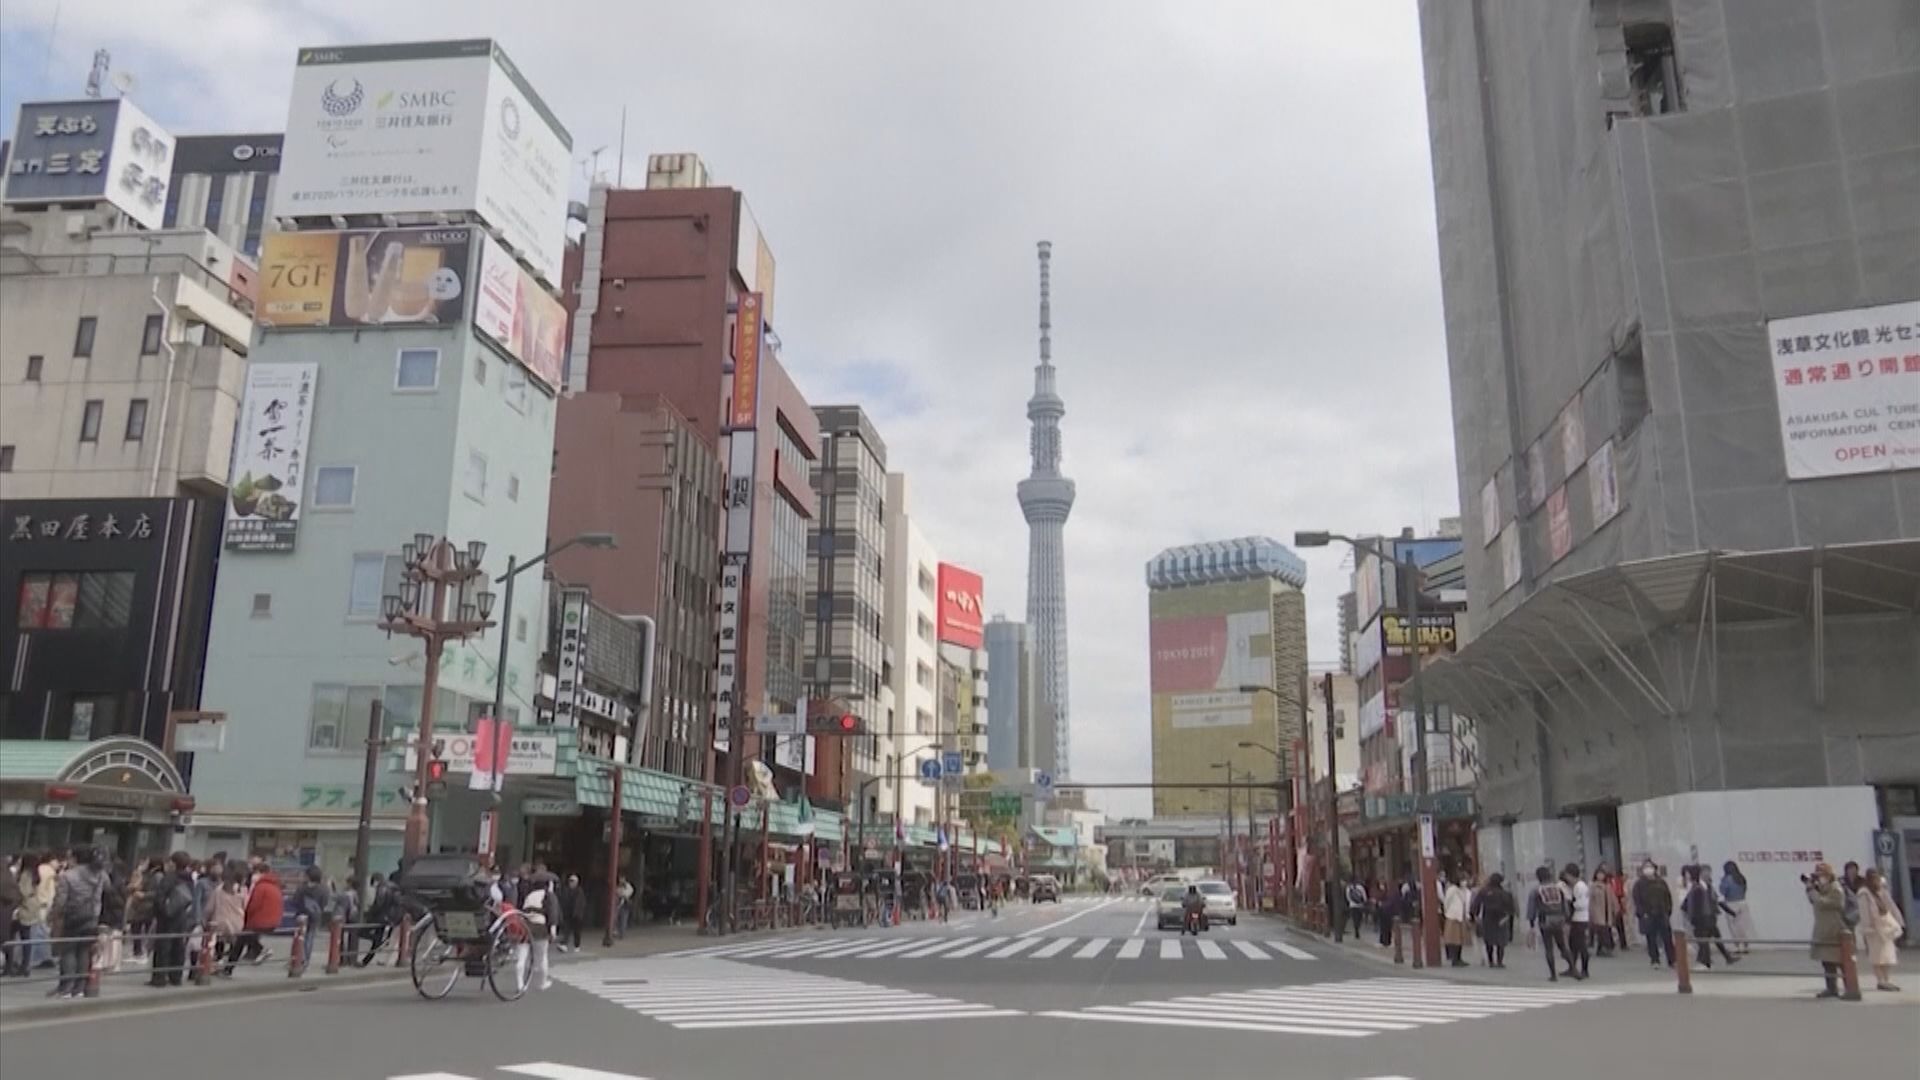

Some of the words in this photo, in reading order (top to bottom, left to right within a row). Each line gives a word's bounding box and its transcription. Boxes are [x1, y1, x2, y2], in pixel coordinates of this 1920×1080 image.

[400, 90, 456, 108] SMBC
[35, 115, 97, 137] 天ぷら
[375, 114, 453, 129] 三井住友銀行
[270, 264, 329, 289] 7GF
[1776, 322, 1920, 355] 浅草文化観光セ
[1787, 410, 1849, 426] ASAKUSA
[1790, 422, 1878, 441] INFORMATION
[1835, 443, 1887, 462] OPEN
[9, 512, 153, 542] 黒田屋本店
